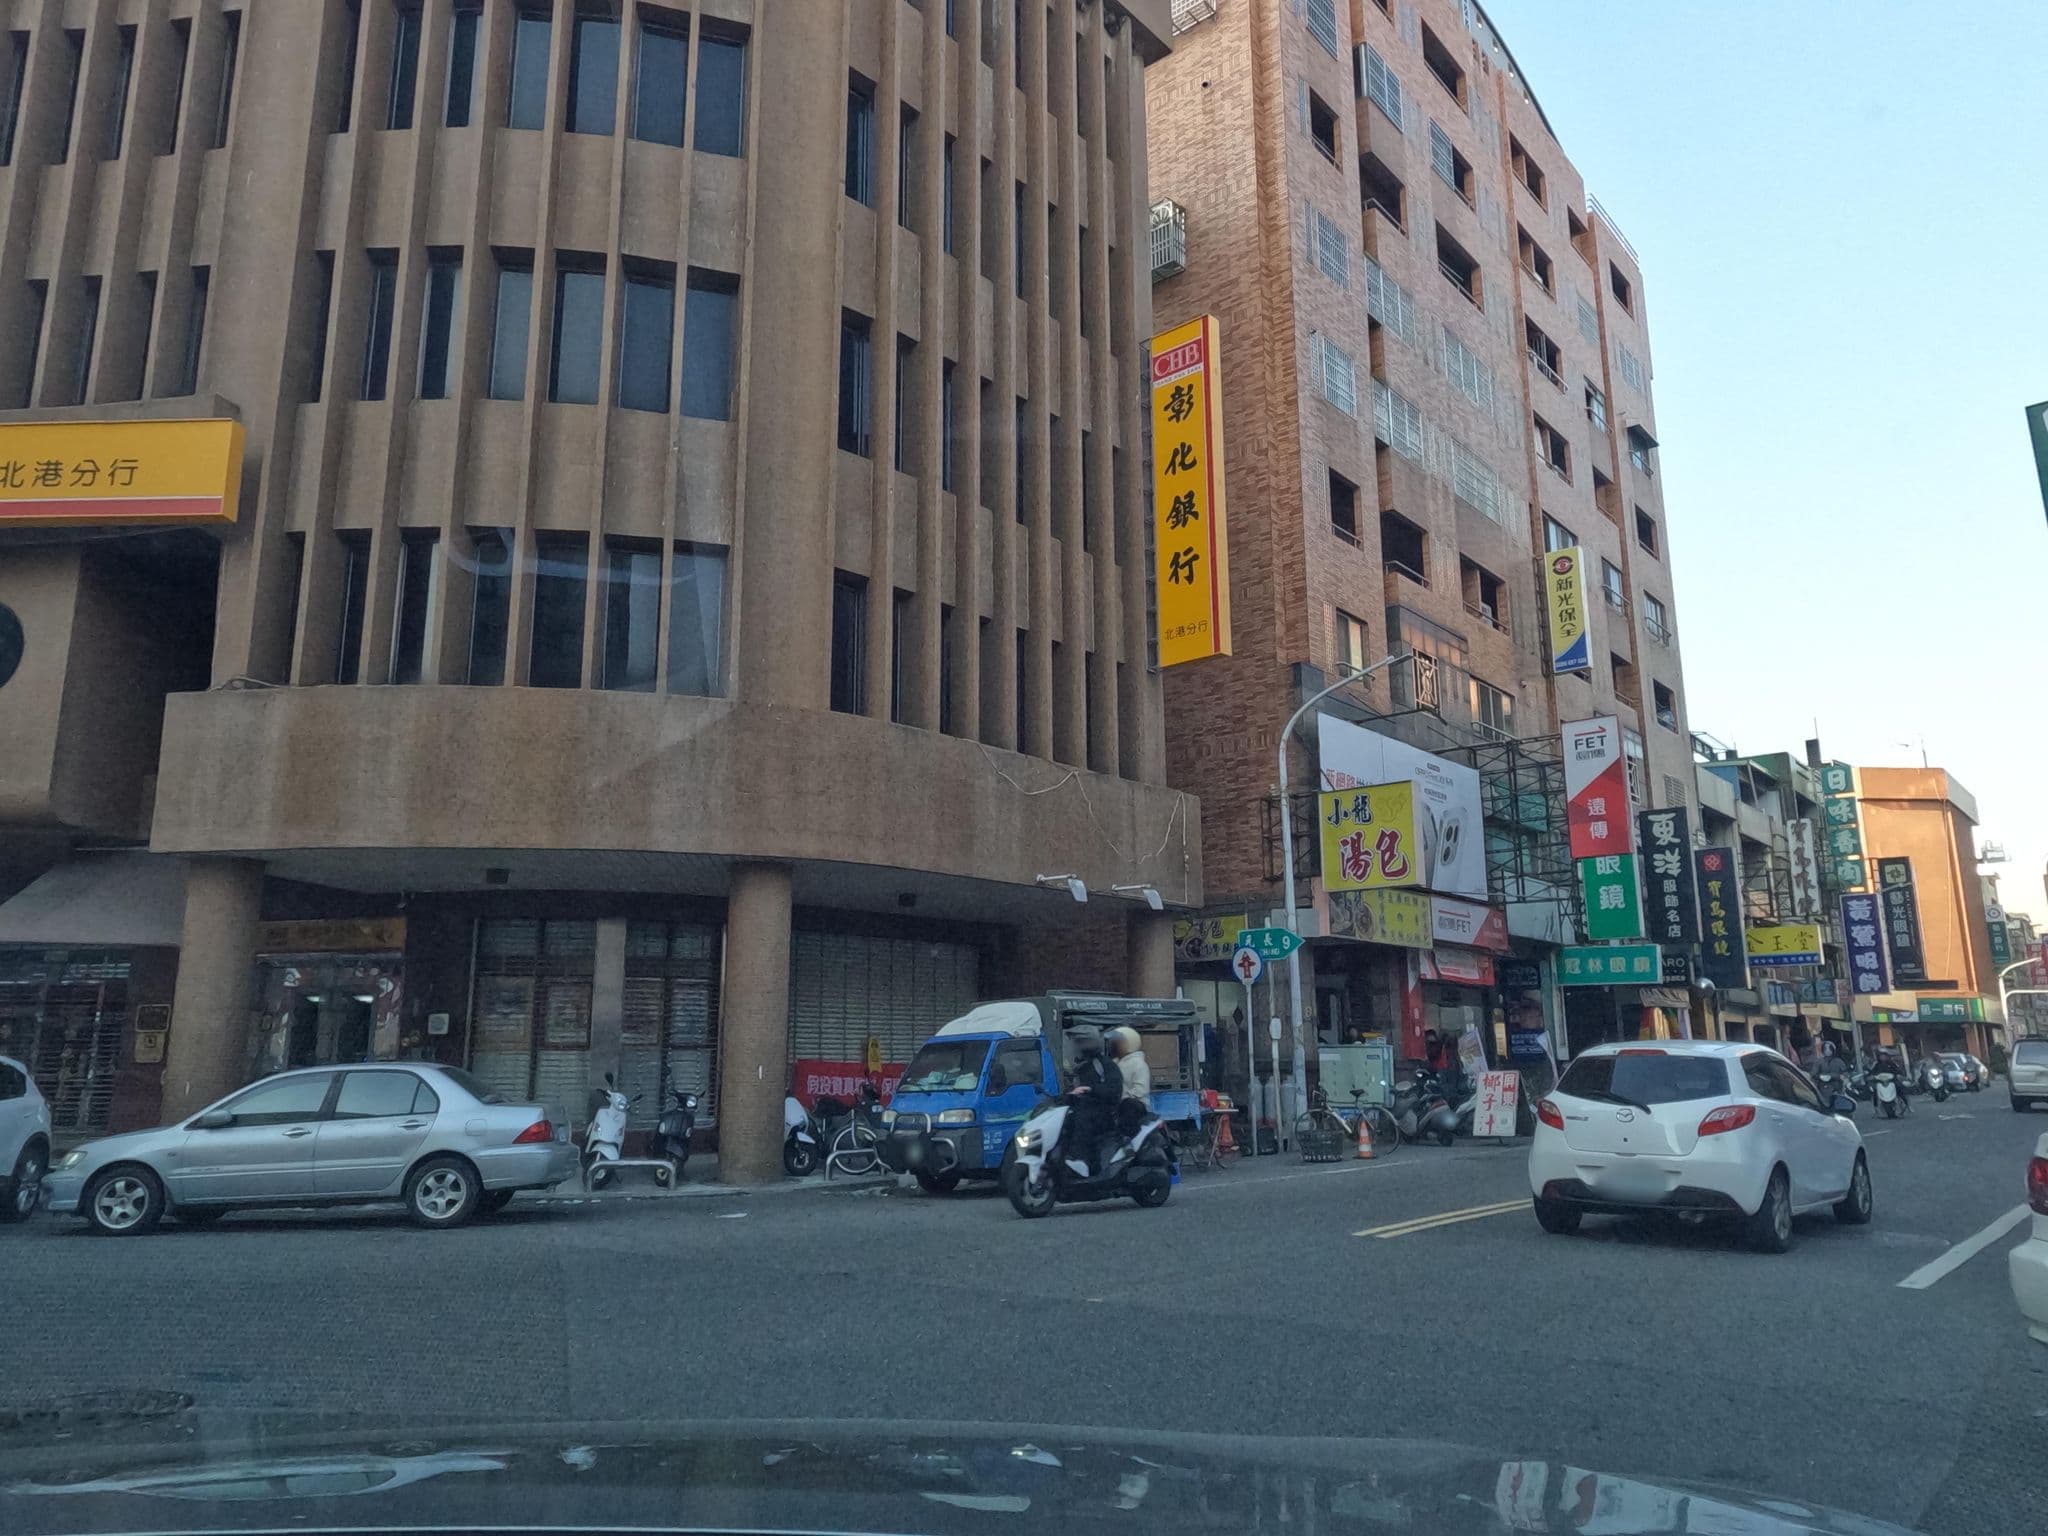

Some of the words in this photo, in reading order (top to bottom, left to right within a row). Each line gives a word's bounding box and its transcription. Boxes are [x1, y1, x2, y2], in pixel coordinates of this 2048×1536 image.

[1154, 343, 1200, 377] CHB
[0, 458, 139, 488] 北港分行
[1163, 383, 1199, 586] 彰化銀行
[1556, 576, 1577, 638] 新光保全
[1164, 619, 1208, 641] 北港分行
[1574, 735, 1607, 751] FET
[1327, 793, 1373, 826] 小龍
[1588, 798, 1609, 841] 遠傳
[1339, 829, 1409, 882] 湯包
[1596, 856, 1626, 911] 眼鏡
[1282, 936, 1291, 949] 9
[1456, 919, 1471, 934] FET
[1480, 1073, 1501, 1135] 椰子汁
